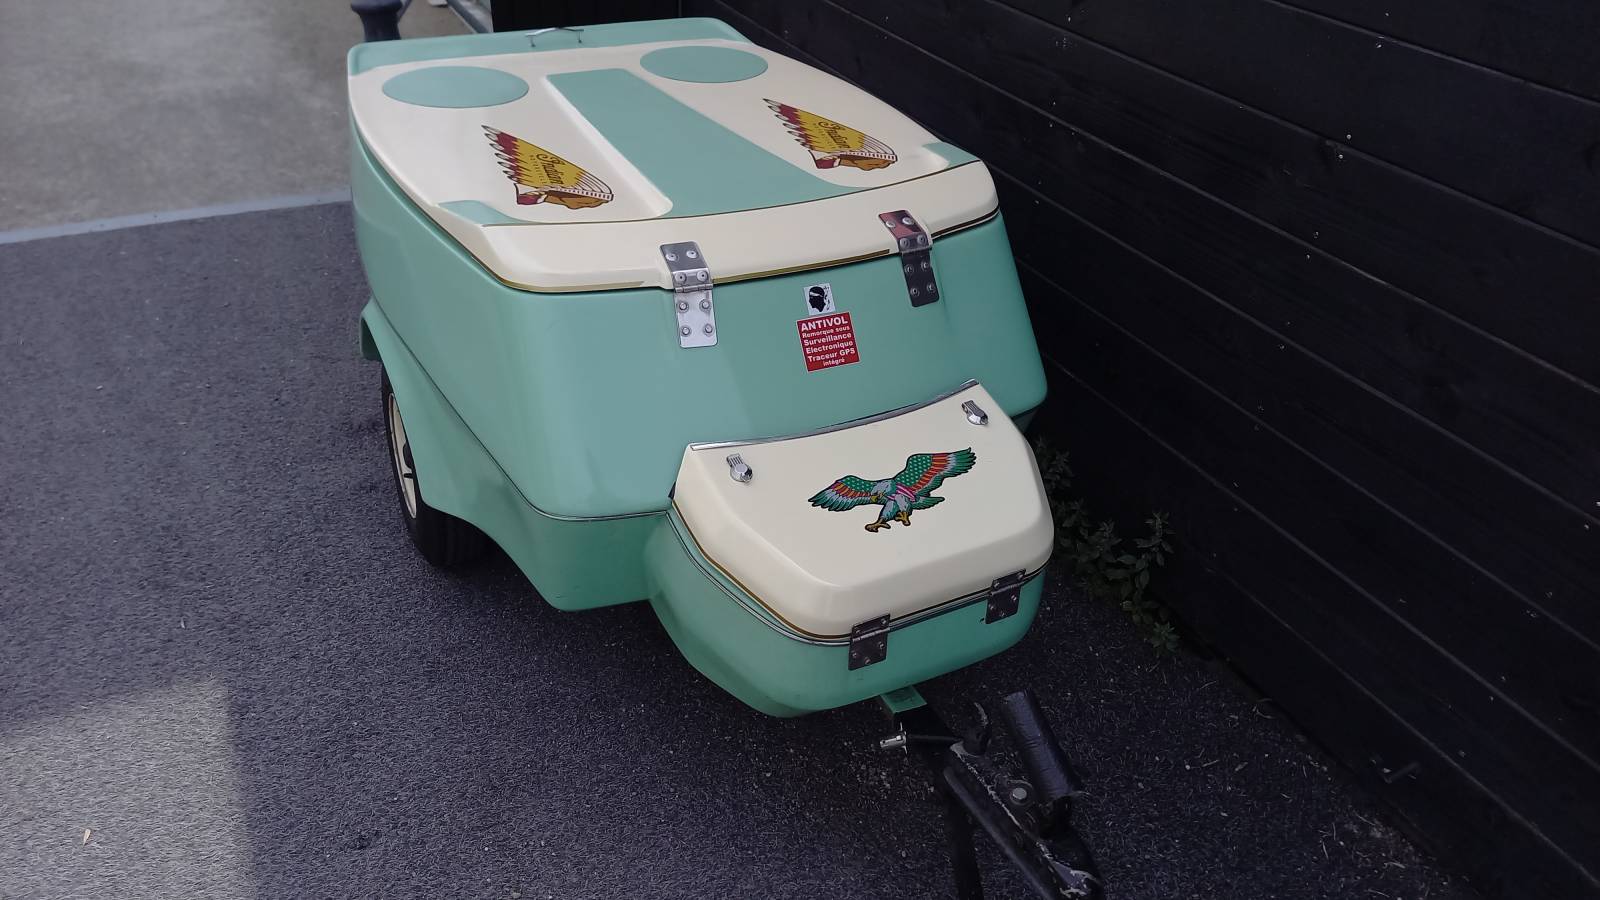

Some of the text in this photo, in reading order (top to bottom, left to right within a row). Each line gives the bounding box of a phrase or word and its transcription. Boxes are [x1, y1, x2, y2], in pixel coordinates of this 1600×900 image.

[818, 121, 850, 149] Indian
[536, 154, 565, 184] Indian
[801, 316, 848, 331] ANTIVOL
[802, 329, 834, 338] Remarque
[804, 332, 851, 346] Surveillance
[805, 340, 853, 354] Electronique
[808, 348, 855, 362] Traceur GPS
